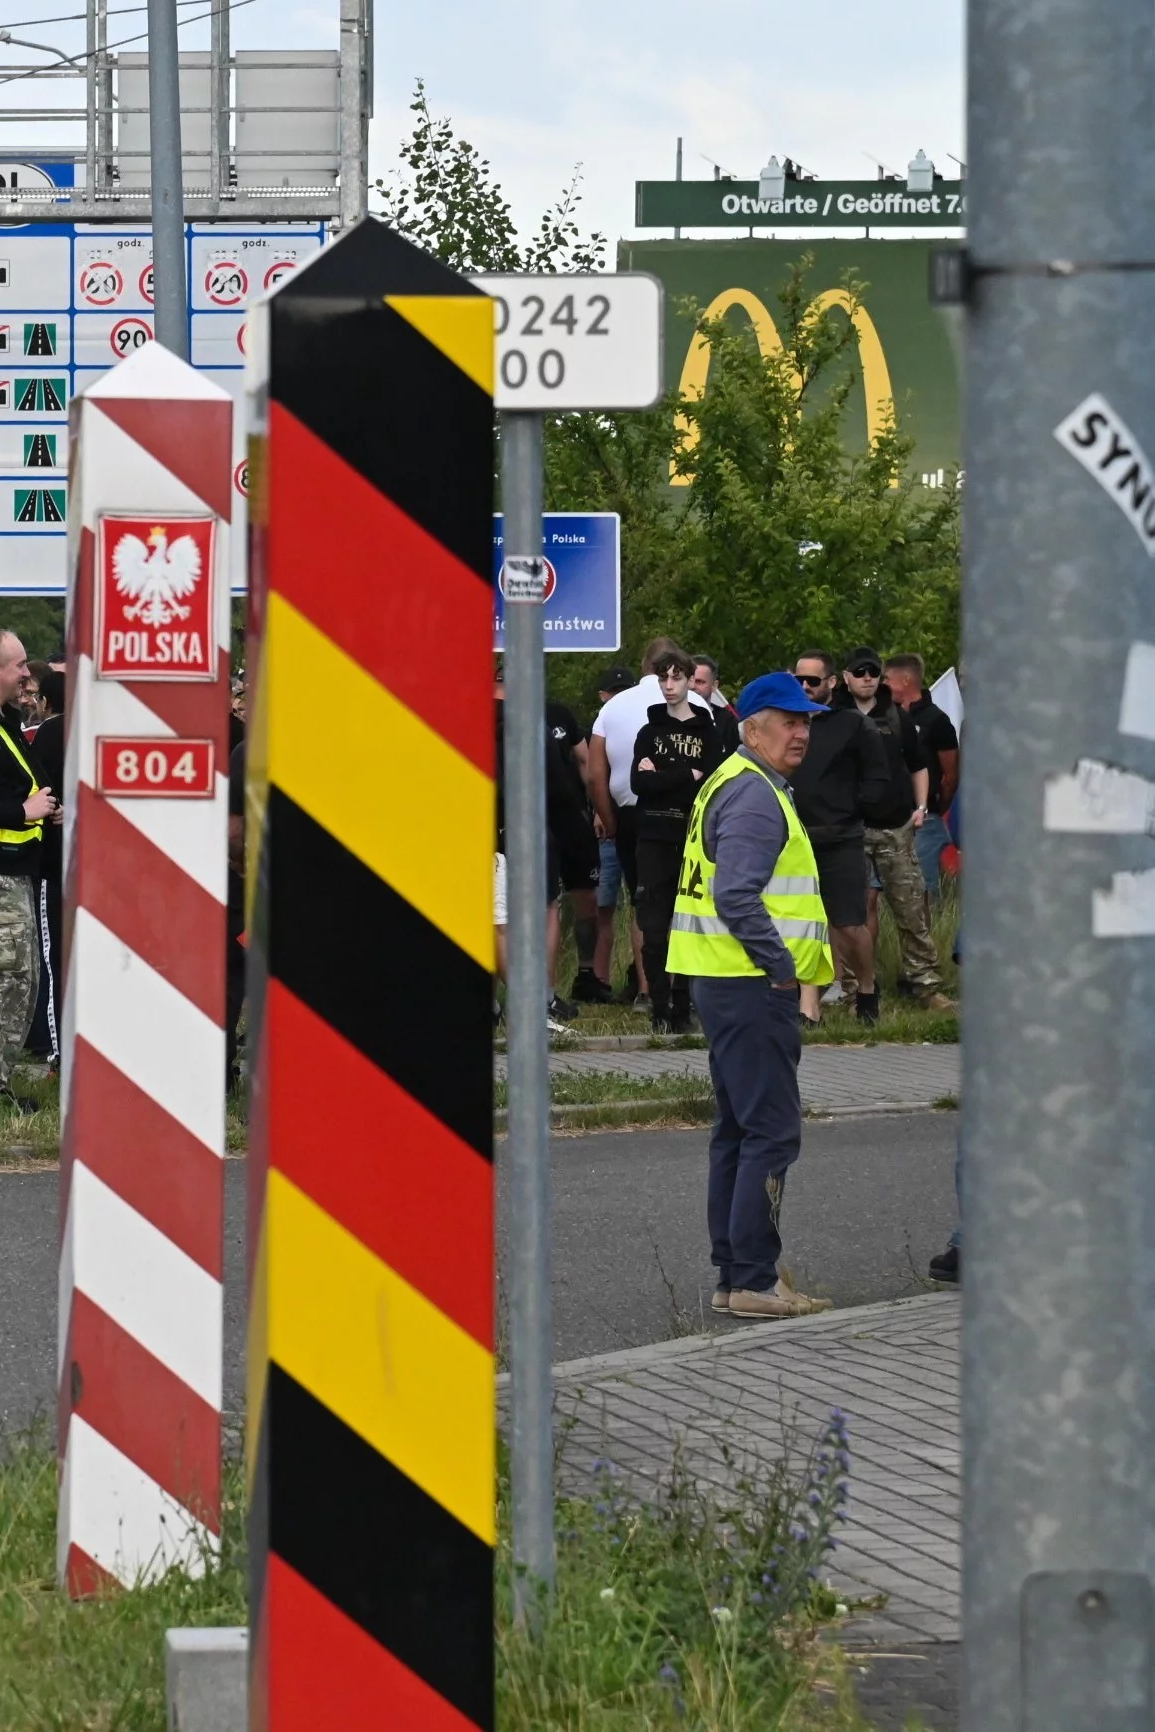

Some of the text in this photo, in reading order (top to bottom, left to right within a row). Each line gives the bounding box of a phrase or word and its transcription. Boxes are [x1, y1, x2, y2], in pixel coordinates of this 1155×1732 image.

[722, 194, 818, 214] Otwarte
[822, 194, 833, 216] /
[837, 193, 940, 214] Geöffnet
[117, 238, 145, 249] godz.
[242, 239, 270, 249] godz.
[118, 330, 146, 350] 90
[552, 534, 586, 543] Polska
[543, 616, 604, 630] aństwa
[108, 630, 203, 664] POLSKA
[116, 750, 196, 784] 804
